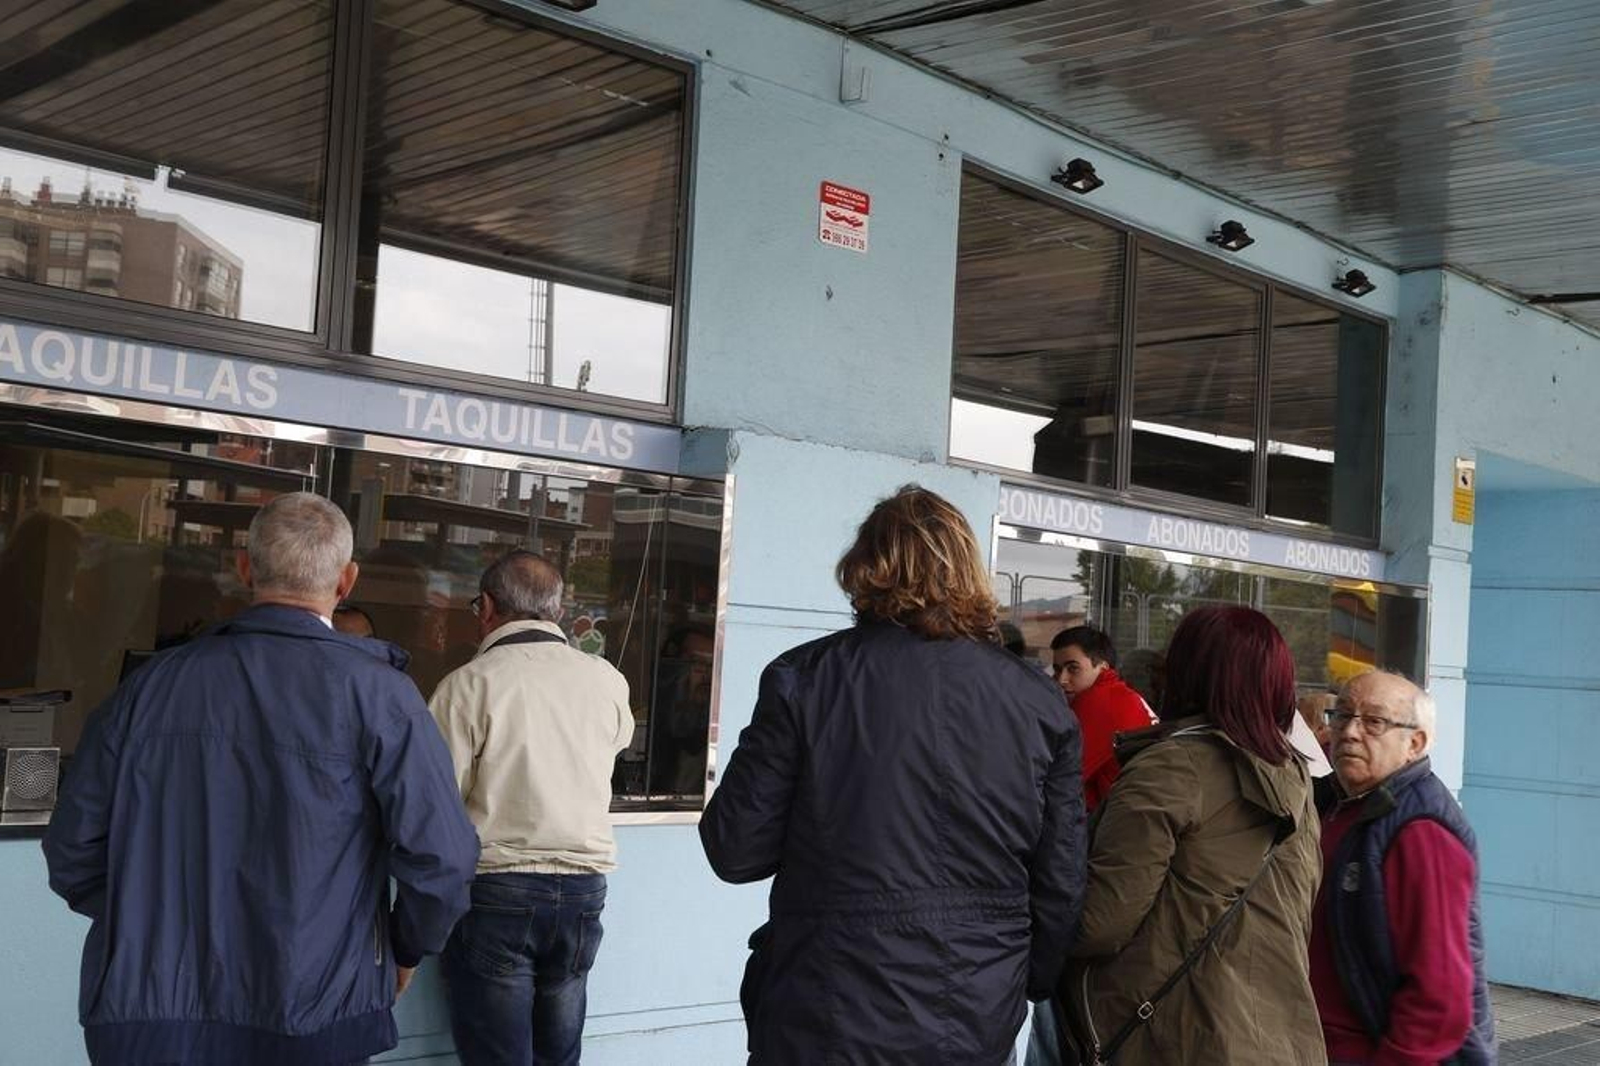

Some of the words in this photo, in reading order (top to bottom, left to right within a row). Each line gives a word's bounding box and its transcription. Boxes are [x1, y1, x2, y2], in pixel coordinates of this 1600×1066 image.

[0, 323, 278, 411] AQUILLAS
[399, 387, 635, 462] TAQUILLAS
[1147, 515, 1250, 558] ABONADOS
[1284, 539, 1370, 576] ABONADOS
